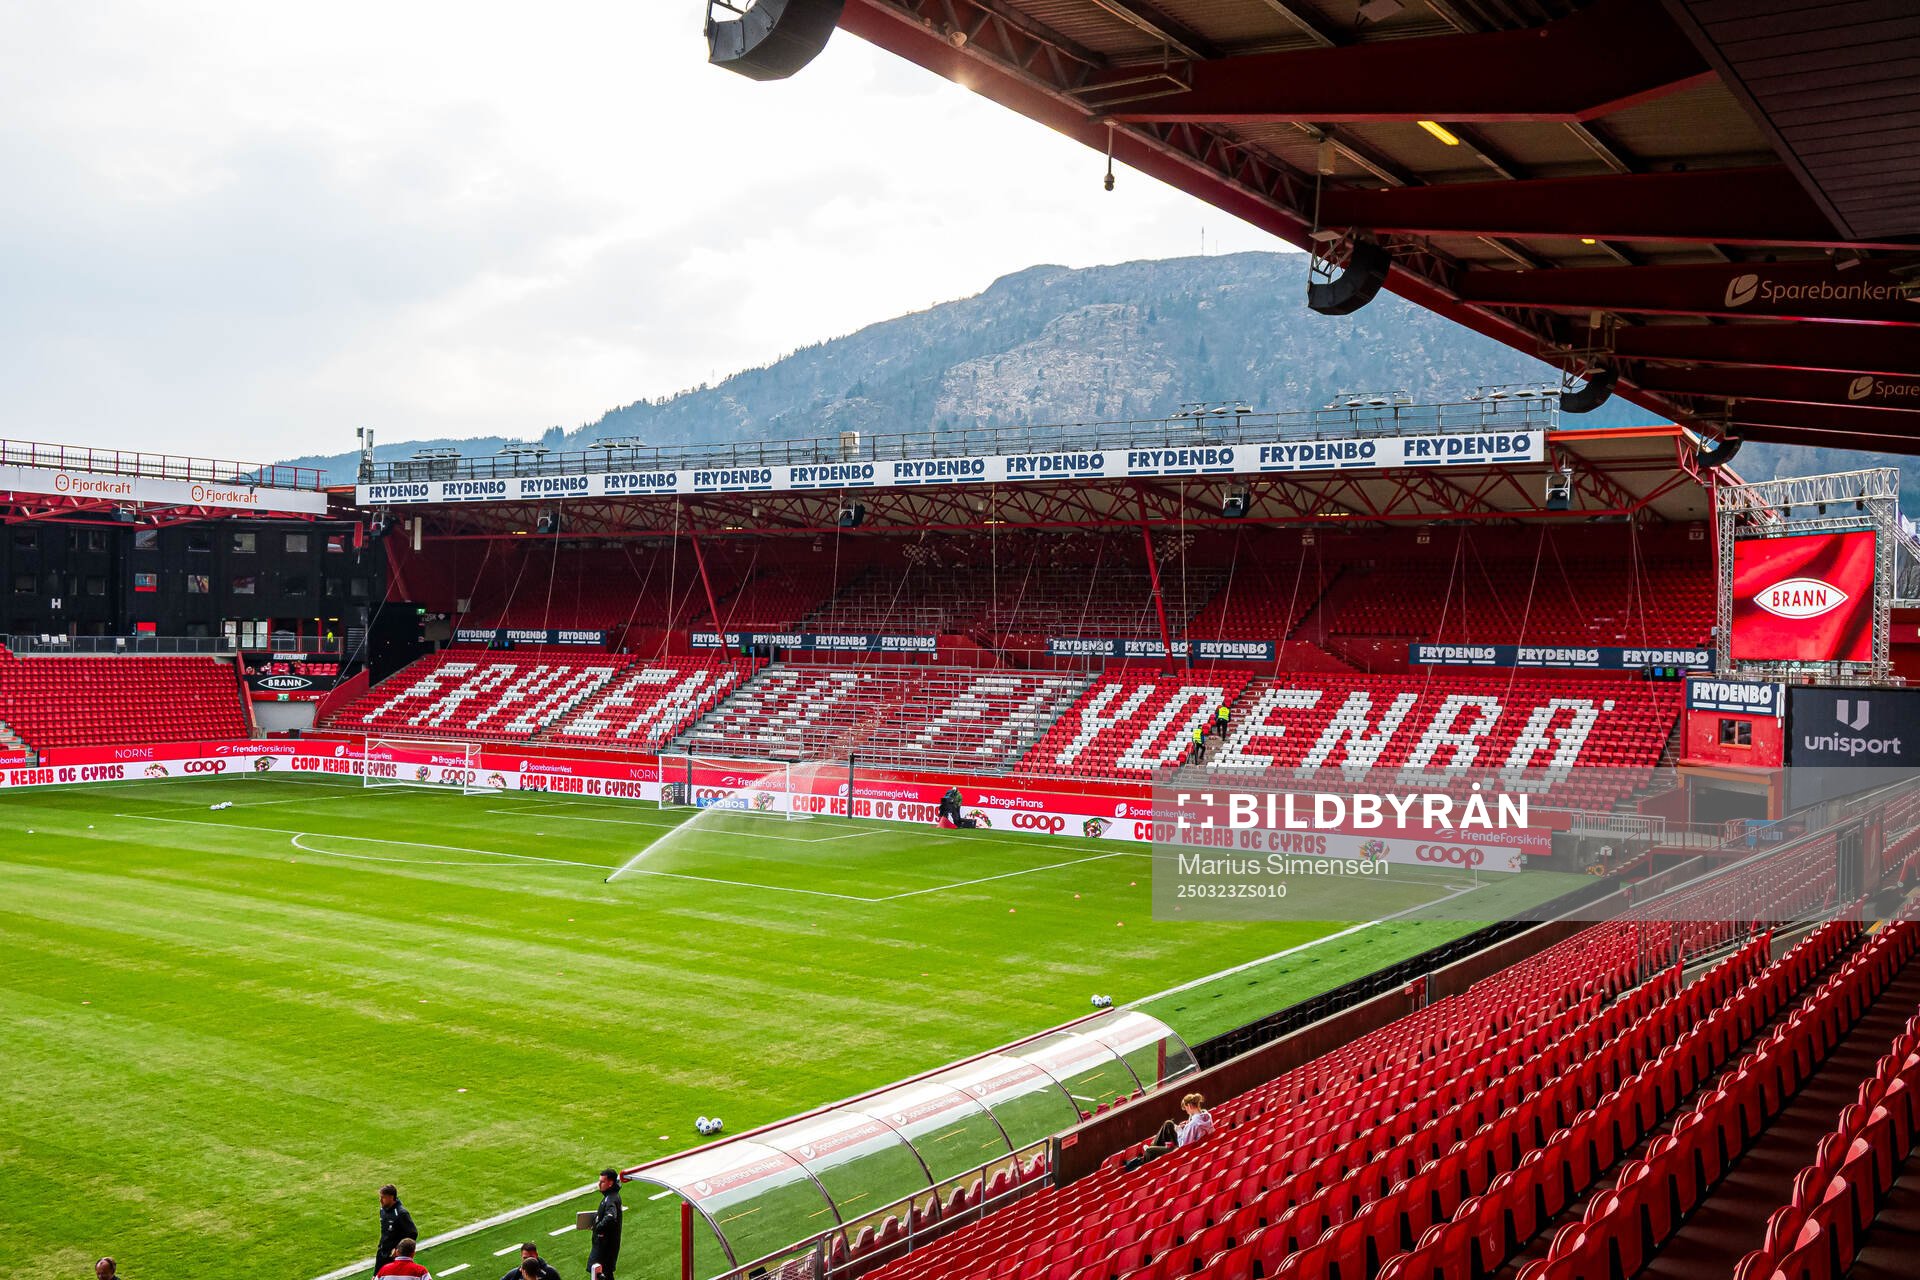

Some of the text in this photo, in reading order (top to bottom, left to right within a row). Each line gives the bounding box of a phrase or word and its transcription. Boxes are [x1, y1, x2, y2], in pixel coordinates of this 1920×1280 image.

[1260, 440, 1376, 463] FRYDENBØ
[1404, 434, 1531, 457] FRYDENBØ
[1007, 452, 1105, 473] FRYDENBØ
[1128, 446, 1235, 468] FRYDENBØ
[694, 467, 773, 486] FRYDENBØ
[790, 463, 875, 483] FRYDENBØ
[894, 458, 985, 479] FRYDENBØ
[72, 478, 131, 494] Fjordkraft
[443, 480, 506, 496] FRYDENBØ
[521, 476, 589, 493] FRYDENBØ
[604, 471, 677, 489] FRYDENBØ
[206, 489, 258, 504] Fjordkraft
[369, 483, 429, 499] FRYDENBØ
[1772, 589, 1828, 607] BRANN
[457, 629, 496, 639] FRYDENBØ
[507, 630, 548, 640] FRYDENBØ
[558, 631, 601, 641] FRYDENBØ
[692, 633, 740, 644] FRYDEBØ
[816, 635, 867, 646] FRYDENBØ
[881, 636, 936, 648] FRYDENBØ
[1053, 639, 1114, 651] FRYDENBØ
[1125, 641, 1188, 653] FRYDEBØ
[1200, 642, 1267, 655] FRYDENBØ
[1419, 646, 1496, 660] FRYDENBØ
[1518, 648, 1600, 662] FRYDENBØ
[1623, 650, 1709, 664] FRYDENBØ
[268, 679, 302, 687] BRANN
[1692, 681, 1773, 706] FRYDENBØ
[232, 745, 296, 754] FrendeForsikring
[1804, 732, 1901, 757] unisport
[114, 748, 155, 760] NORNE
[10, 769, 54, 785] KEBAB
[59, 767, 76, 782] OG
[81, 764, 125, 781] GYROS
[184, 759, 226, 775] coop
[291, 757, 320, 770] COOP
[323, 758, 350, 774] KEBAB
[367, 760, 397, 777] GYROS
[550, 777, 584, 794] KEBAB
[587, 779, 601, 795] OG
[605, 780, 641, 798] GYROS
[792, 795, 826, 813] COOP
[875, 801, 893, 818] OG
[990, 796, 1044, 809] Brage Finans
[1011, 813, 1065, 835] coop
[1133, 822, 1327, 855] COOP KEBAB OG GYROS
[1415, 844, 1484, 870] coop
